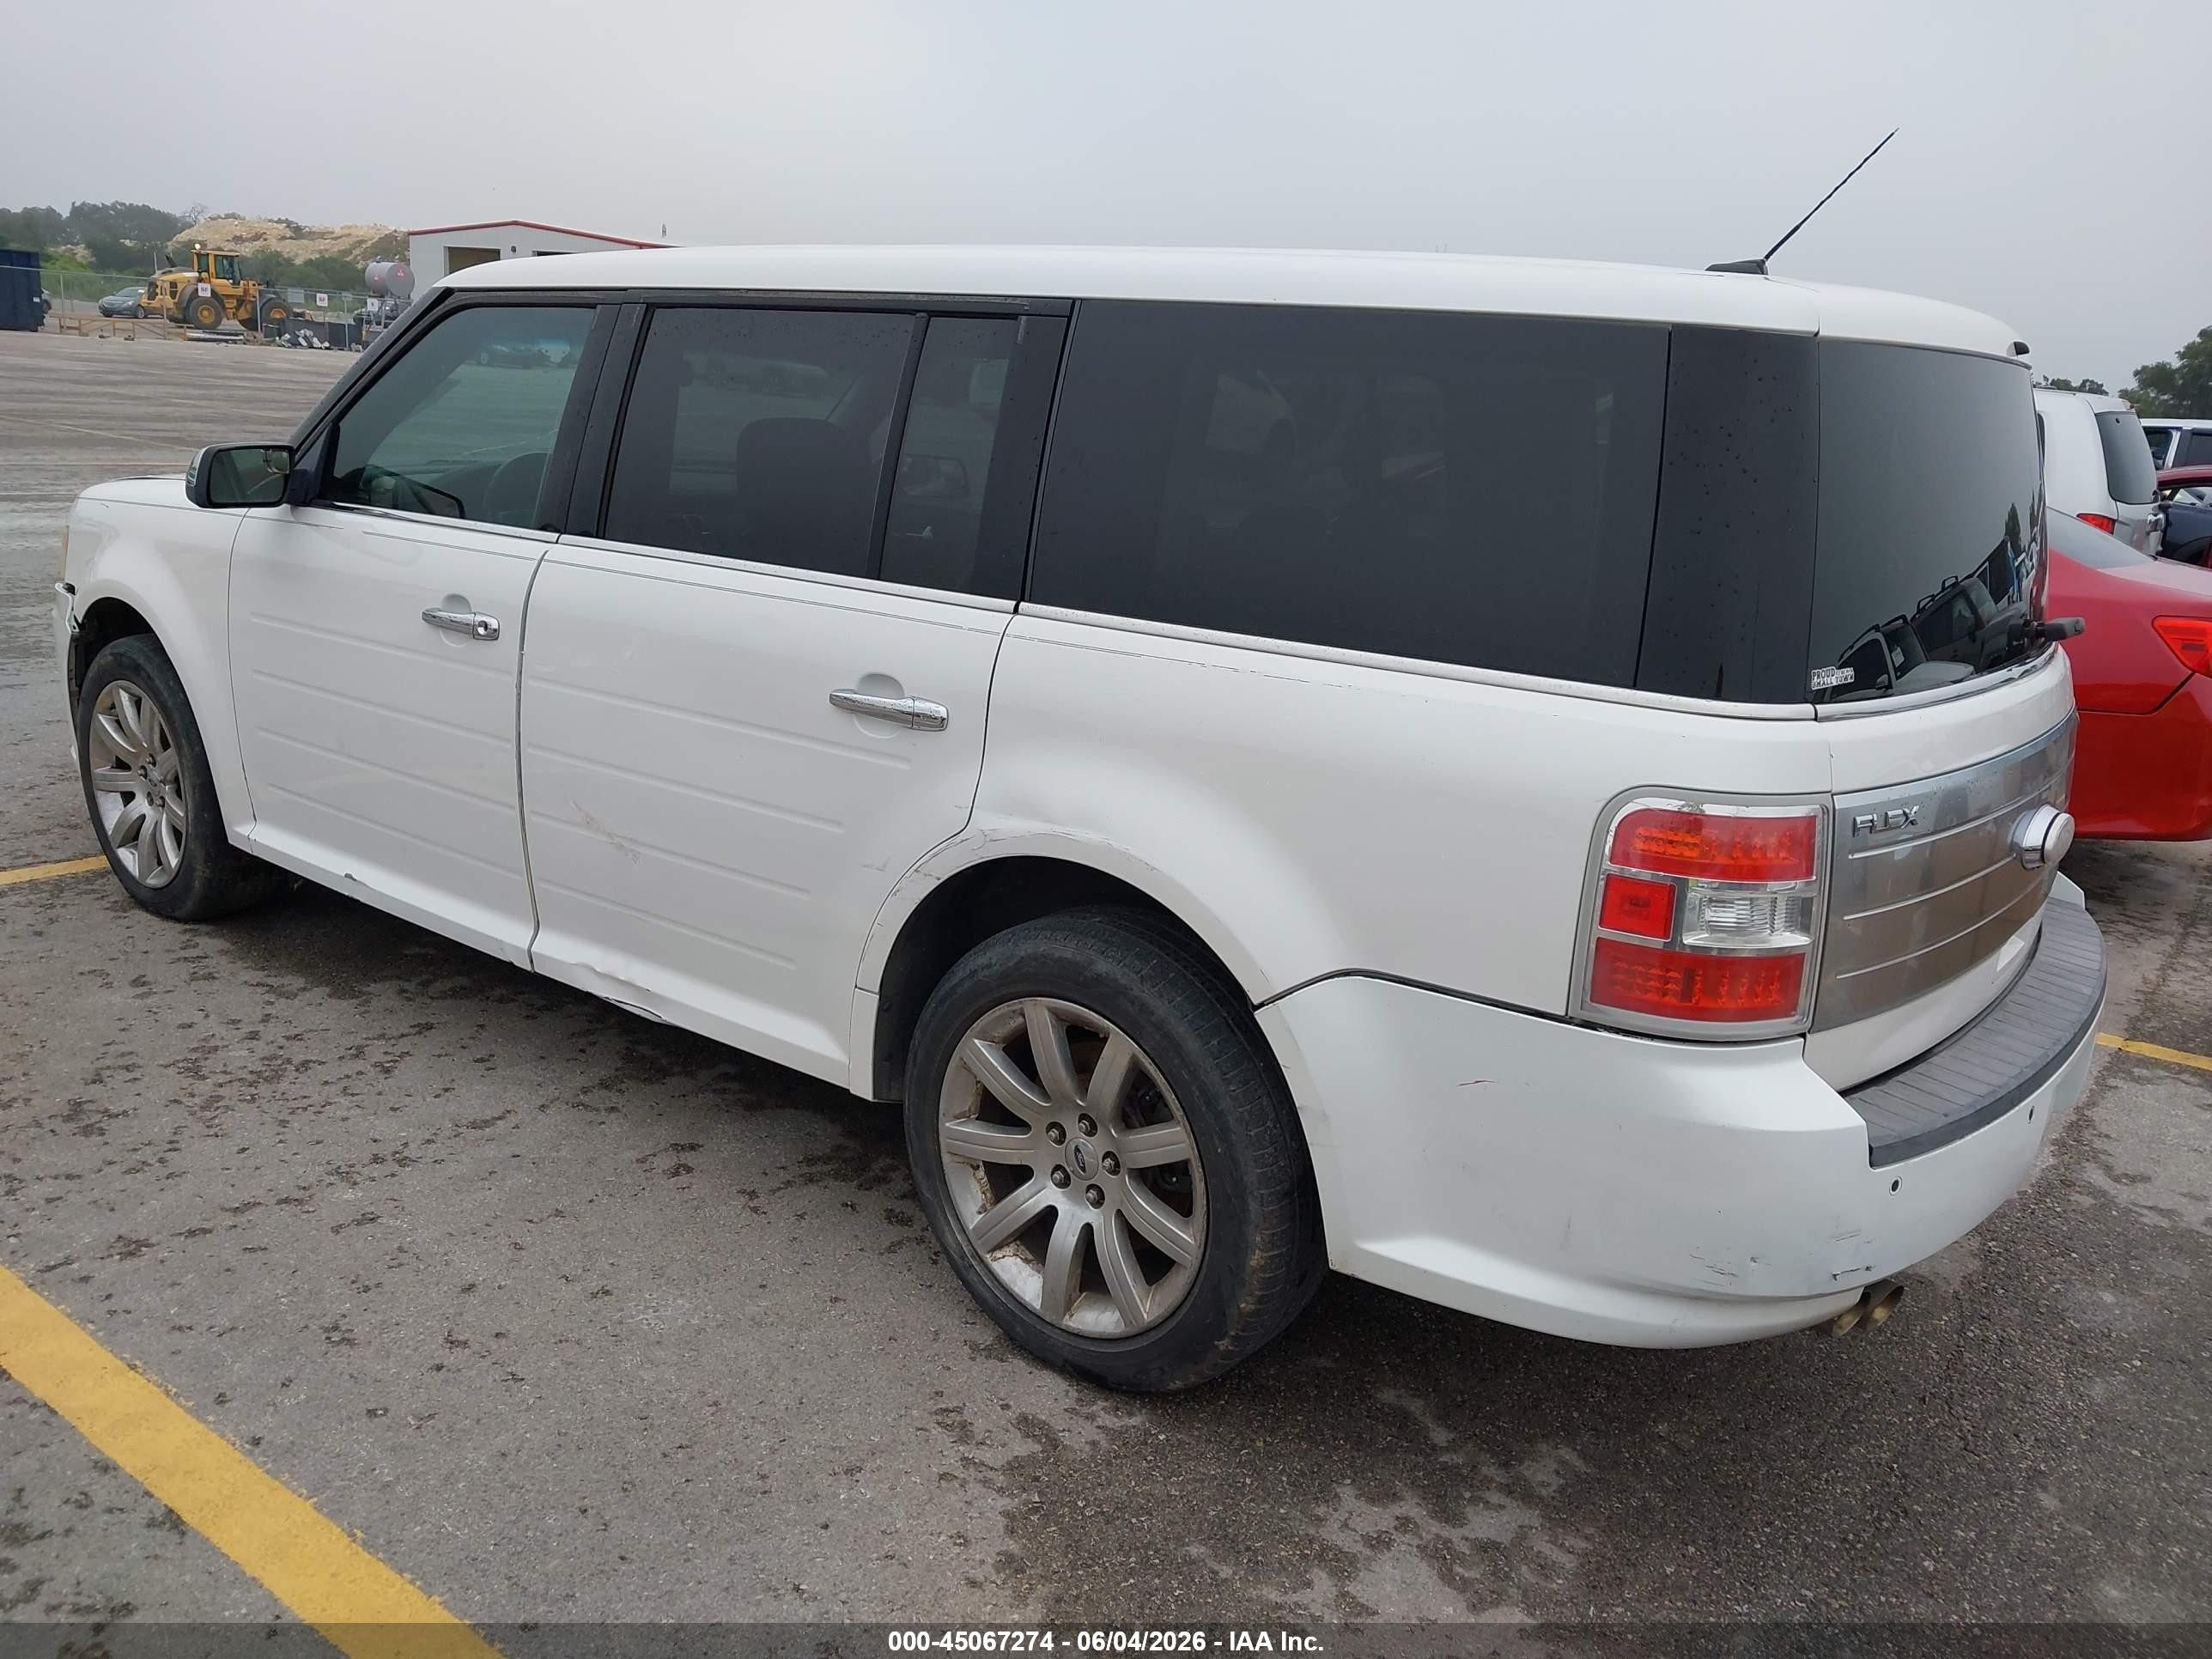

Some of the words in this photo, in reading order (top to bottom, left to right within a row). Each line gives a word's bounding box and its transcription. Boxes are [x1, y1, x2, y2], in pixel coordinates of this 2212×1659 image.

[1812, 668, 1836, 680] PROUD
[1835, 673, 1854, 684] TOWN
[1852, 805, 1919, 837] FLEX
